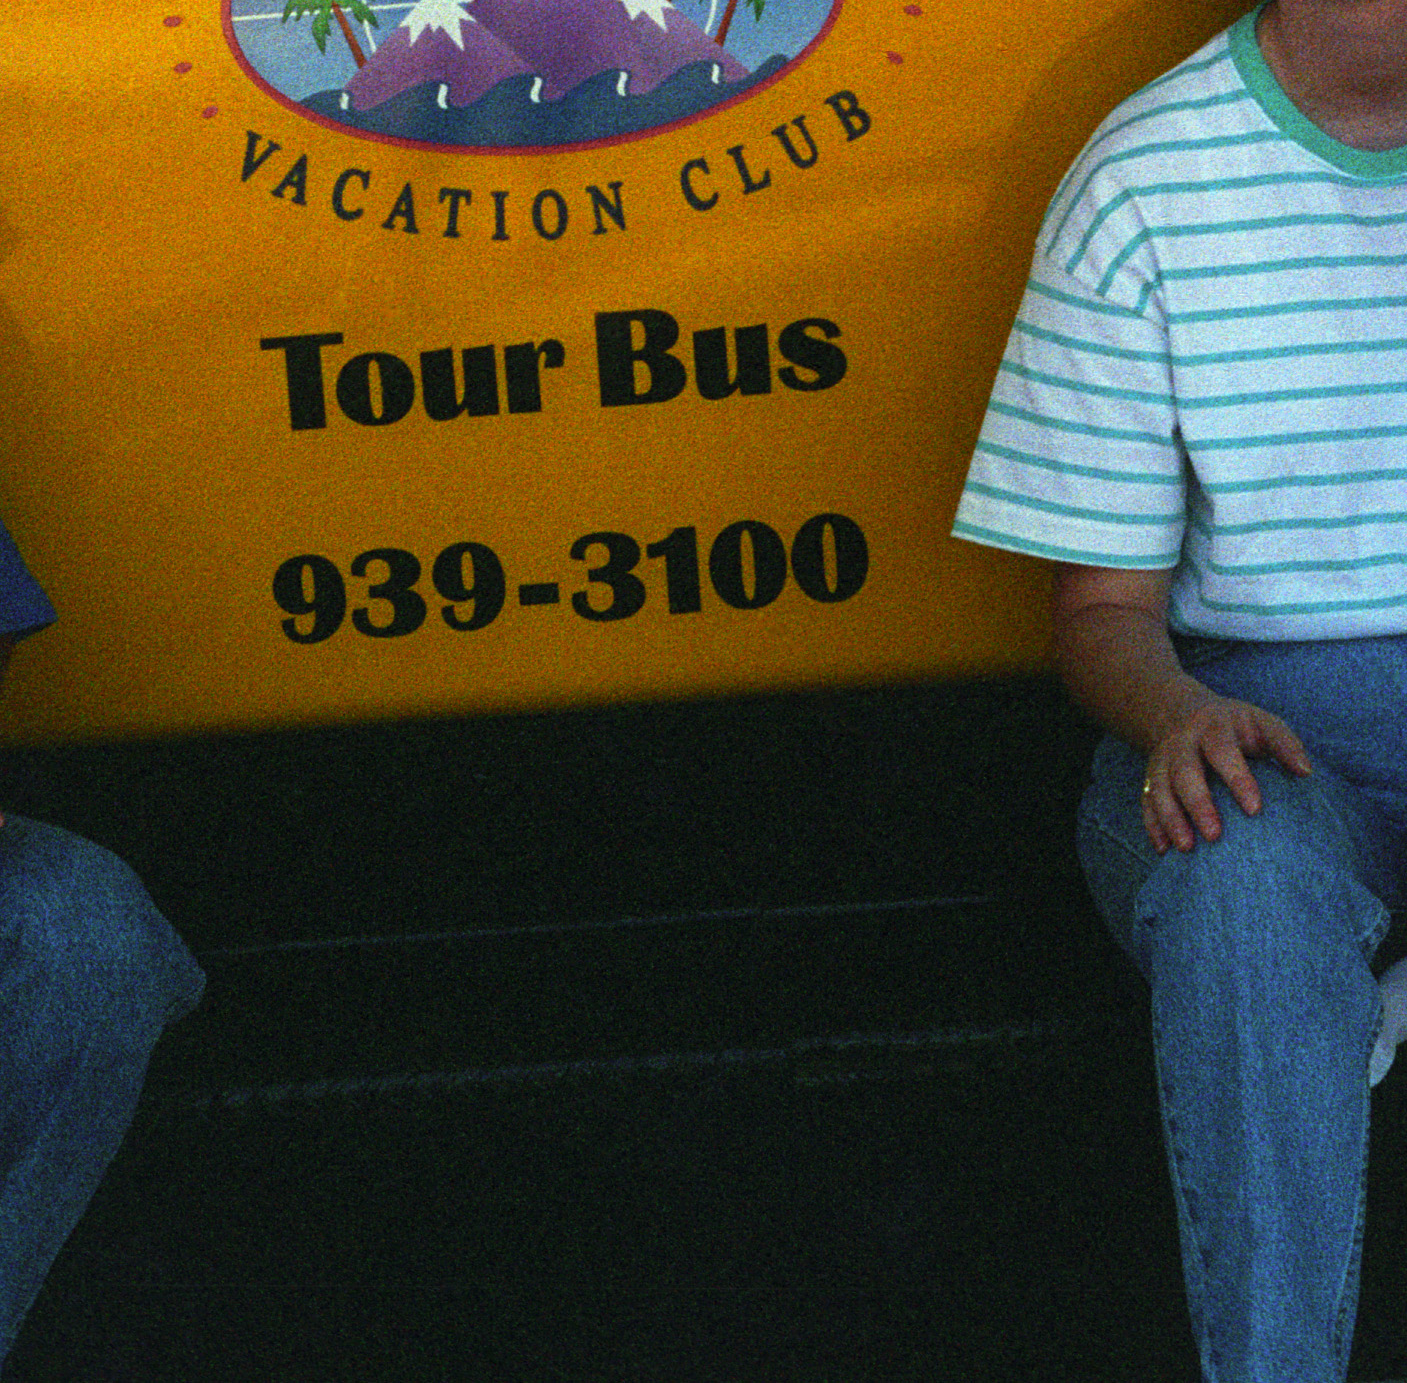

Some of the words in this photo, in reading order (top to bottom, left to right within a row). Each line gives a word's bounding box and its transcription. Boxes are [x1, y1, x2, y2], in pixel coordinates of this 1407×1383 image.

[240, 131, 628, 241] VACATION
[679, 89, 873, 212] CLUB
[260, 332, 566, 432] Tour
[595, 308, 849, 408] Bus
[271, 512, 870, 645] 939-3100
